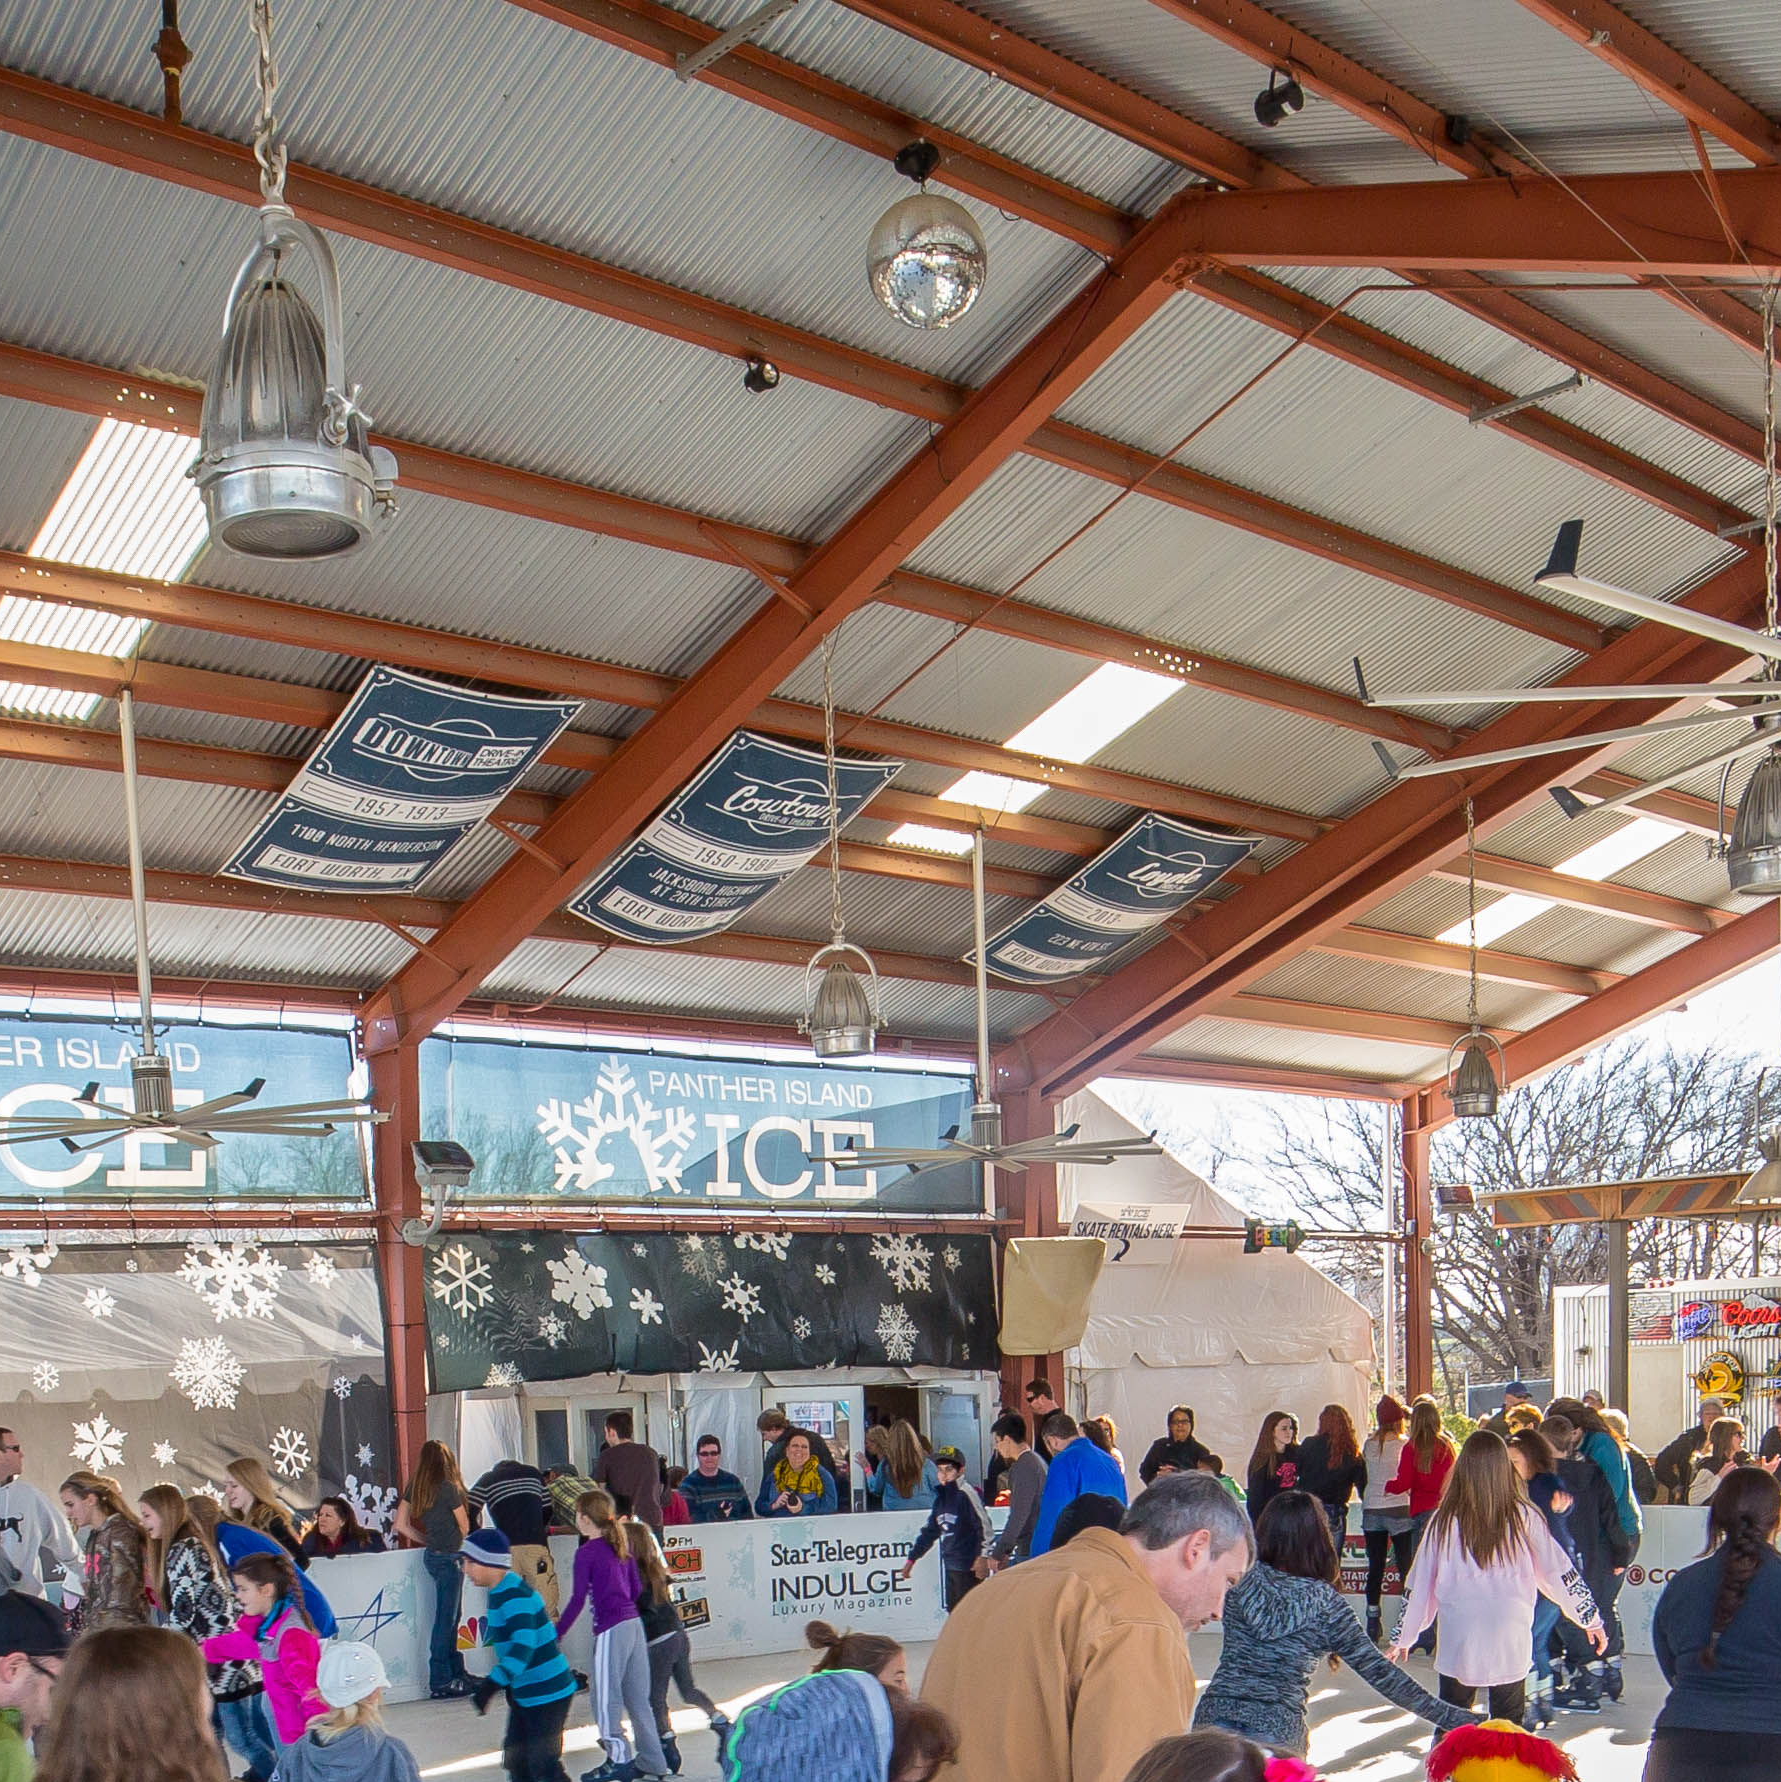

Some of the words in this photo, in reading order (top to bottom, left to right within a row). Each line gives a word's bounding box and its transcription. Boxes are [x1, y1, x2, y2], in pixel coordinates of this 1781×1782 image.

[353, 717, 473, 768] DOWNTOWN
[352, 797, 450, 820] 1957-1973
[723, 785, 842, 825] Cowtown
[326, 833, 372, 851] NORTH
[374, 838, 445, 853] HENDERSON
[269, 853, 319, 872] FORT
[324, 862, 382, 879] WORTH,
[392, 866, 415, 878] TX
[649, 867, 718, 895] JACKSBORO
[613, 896, 657, 919] FORT
[650, 885, 670, 898] AT
[669, 890, 700, 906] 28TH
[1006, 949, 1037, 965] FORT
[649, 1070, 776, 1102] PANTHER
[785, 1079, 872, 1109] ISLAND
[705, 1114, 876, 1198] ICE
[1074, 1221, 1109, 1238] SKATE
[1108, 1223, 1151, 1239] RENTALS
[1152, 1223, 1177, 1239] HERE
[1722, 1300, 1781, 1325] Coors
[1728, 1323, 1780, 1340] LIGHT
[771, 1539, 913, 1567] Star-Telegram
[772, 1570, 912, 1602] INDULGE
[772, 1601, 826, 1617] Luxury
[834, 1594, 913, 1611] Magazine
